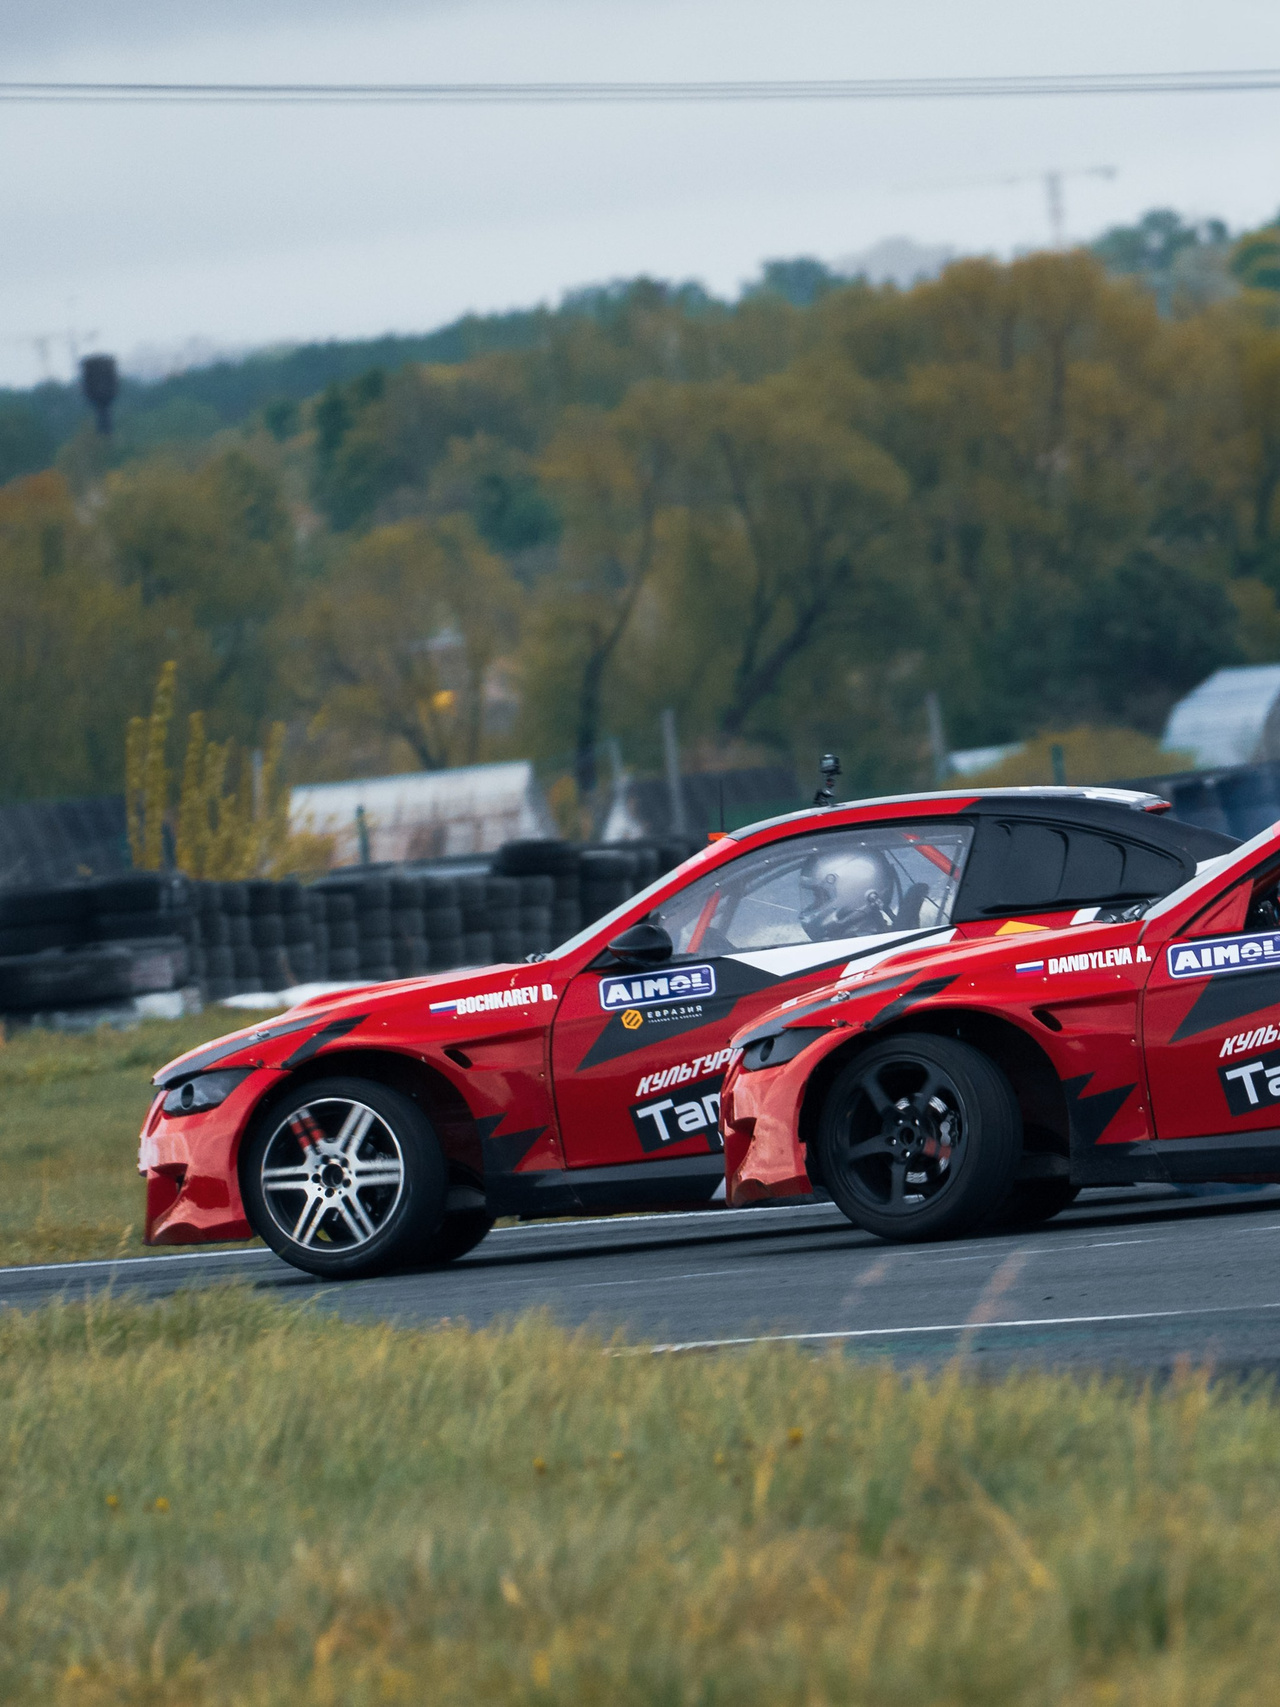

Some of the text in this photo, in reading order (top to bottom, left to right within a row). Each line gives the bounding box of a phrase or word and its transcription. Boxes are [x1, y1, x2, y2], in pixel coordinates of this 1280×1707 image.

[1048, 945, 1152, 975] DANDYLEVA A.
[456, 983, 558, 1015] BOCHKAREV D.
[606, 973, 710, 1004] AIMOL
[647, 1005, 702, 1019] ЕВРАЗИЯ
